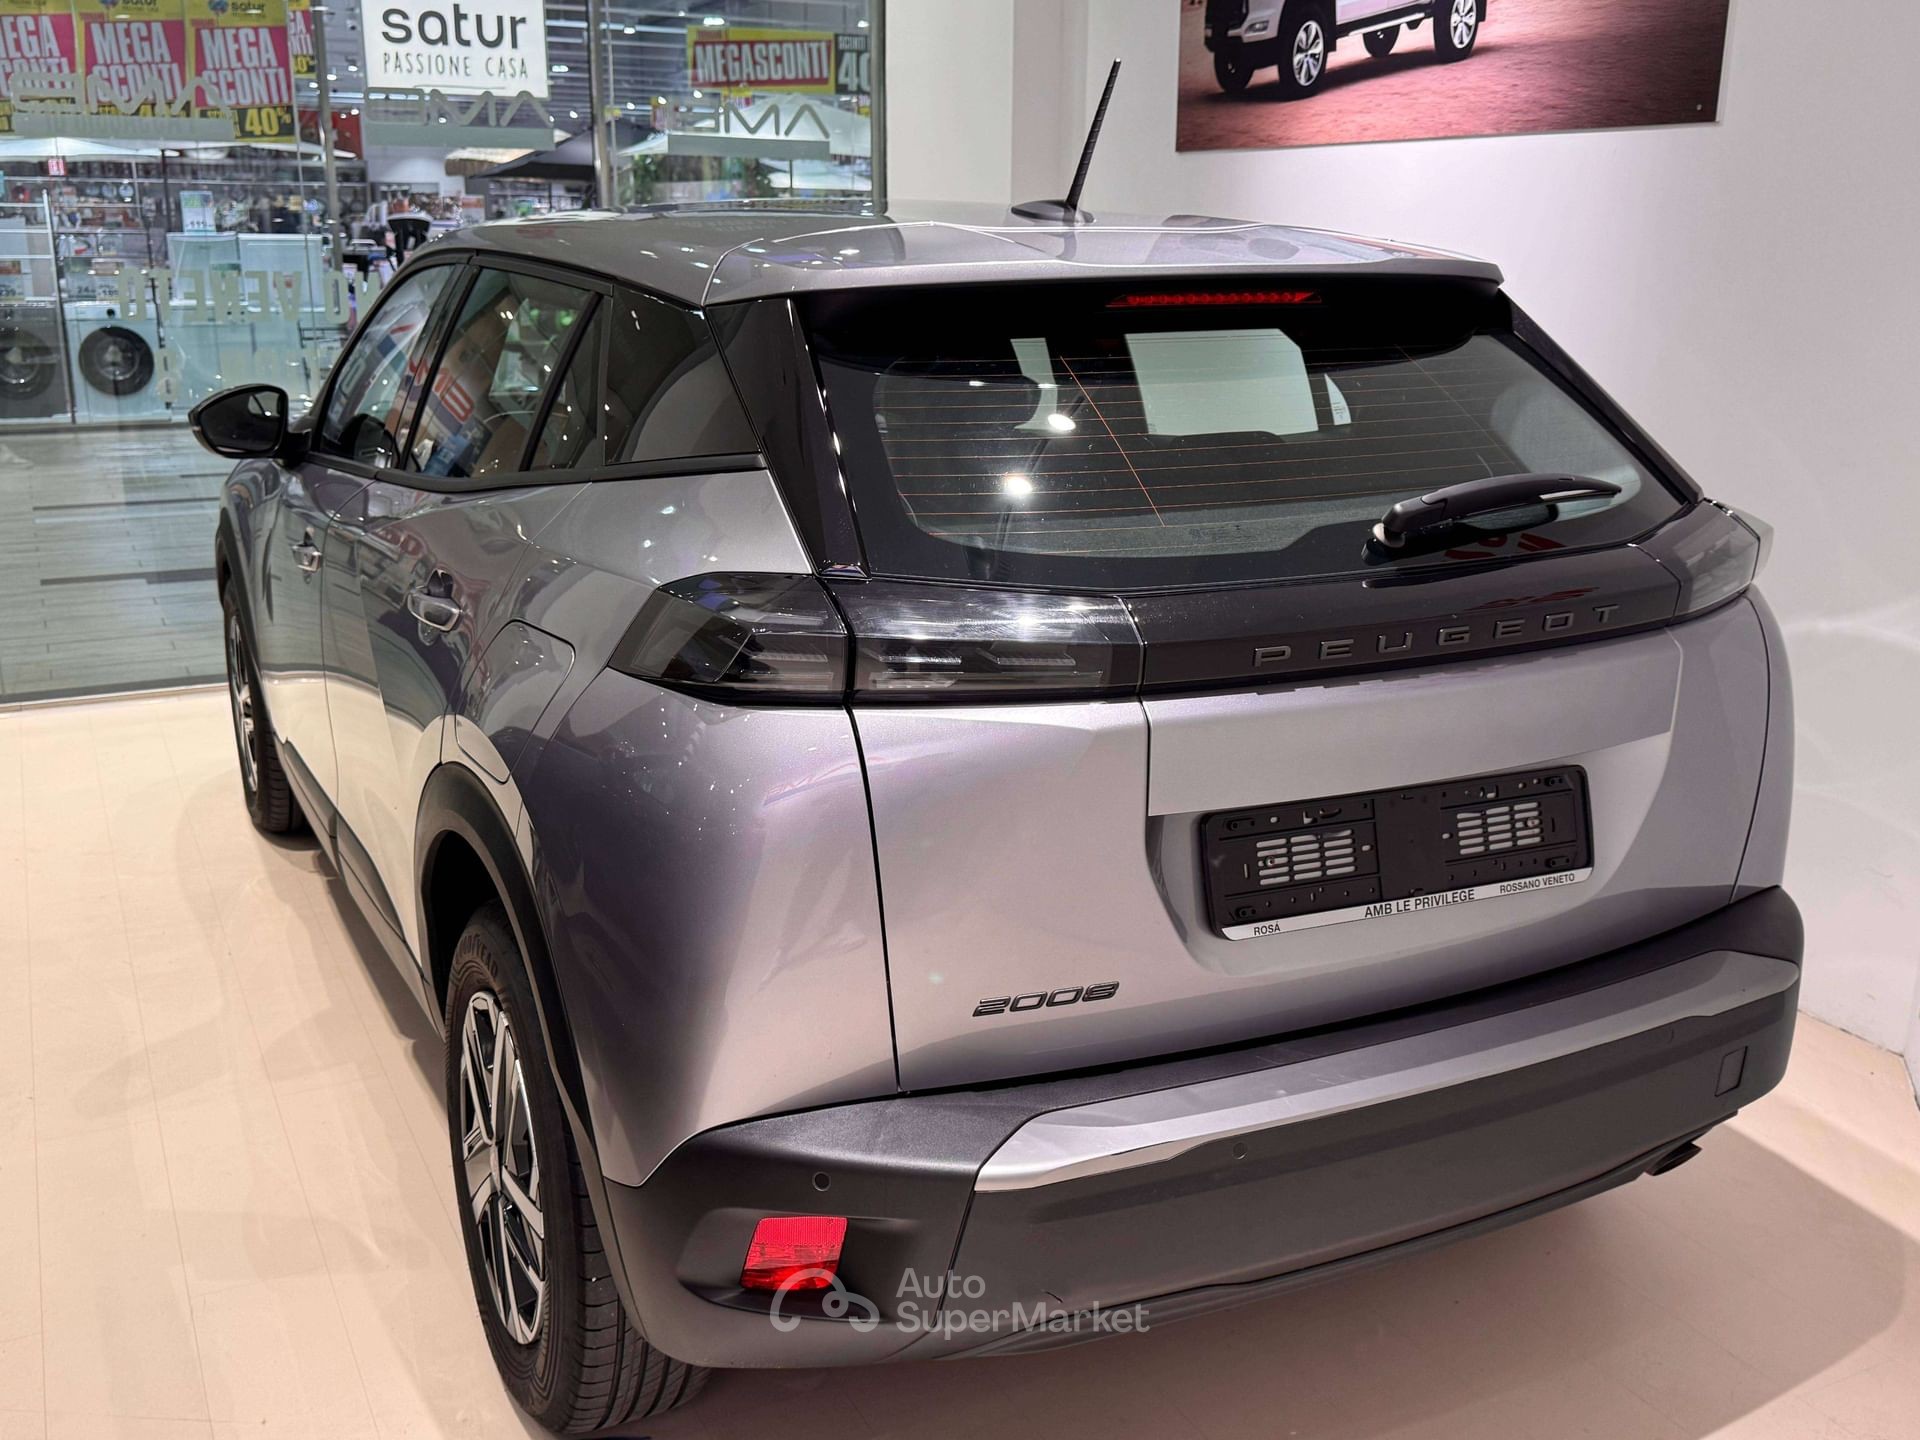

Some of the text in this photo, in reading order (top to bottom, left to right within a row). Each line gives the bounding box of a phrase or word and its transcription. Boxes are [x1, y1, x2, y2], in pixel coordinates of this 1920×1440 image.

[0, 15, 61, 59] EGA
[91, 22, 172, 64] MEGA
[382, 4, 527, 49] satur
[201, 28, 278, 70] MEGA
[383, 51, 529, 80] PASSIONE CASA
[694, 41, 829, 82] MEGASCONTI
[92, 63, 184, 103] SCONTI
[202, 67, 289, 106] SCONTI
[1254, 605, 1619, 667] PEUGEOT
[1364, 889, 1475, 917] AMB LE PRIVILEGE
[1500, 873, 1575, 893] ROSSANO VENETO
[972, 981, 1119, 1017] 2008
